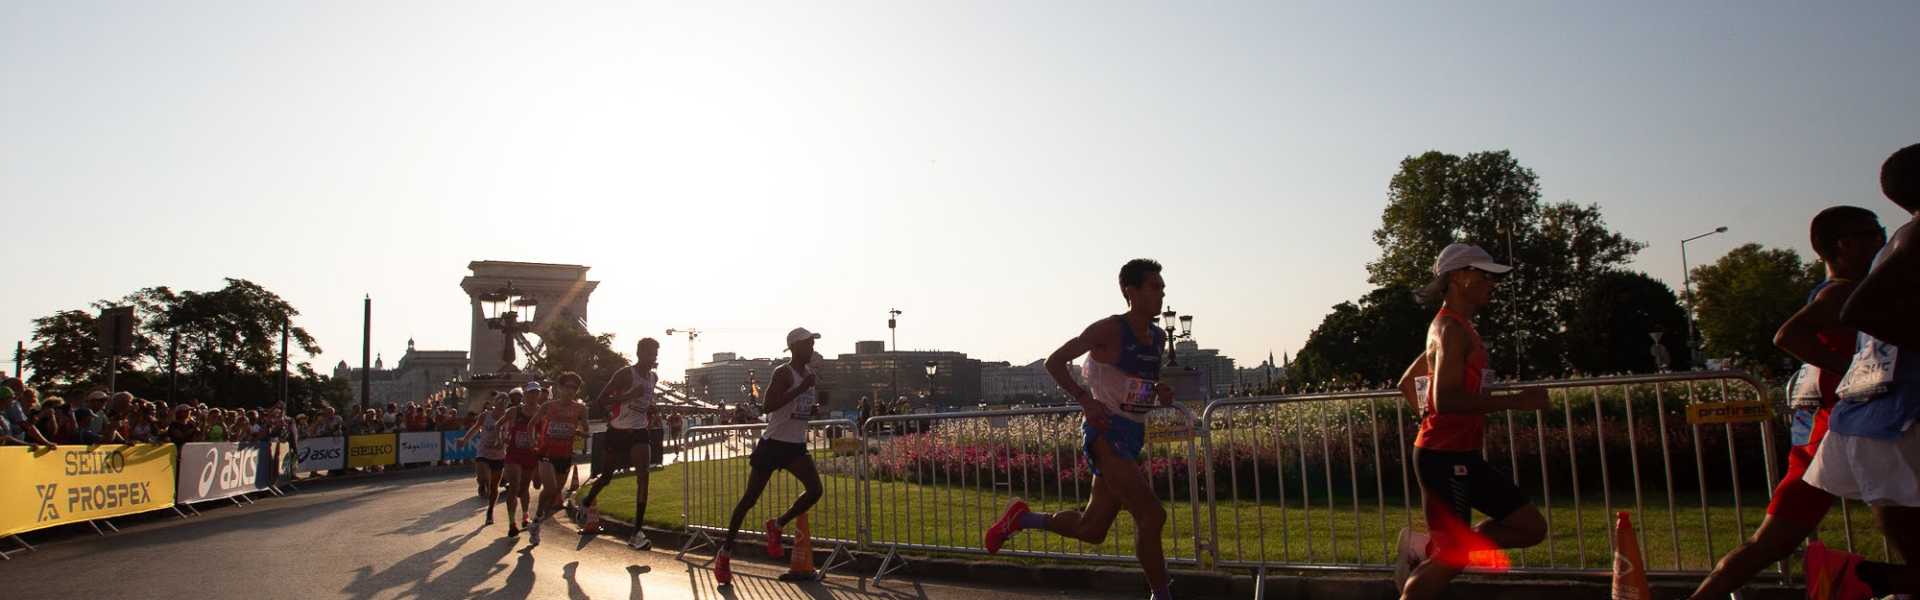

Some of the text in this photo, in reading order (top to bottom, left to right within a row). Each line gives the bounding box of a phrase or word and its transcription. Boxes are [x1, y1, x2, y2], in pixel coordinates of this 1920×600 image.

[64, 450, 125, 476] SEIKO
[310, 447, 341, 461] asics
[350, 444, 393, 457] SEIKO
[220, 446, 259, 490] asics
[67, 480, 151, 513] PROSPEX
